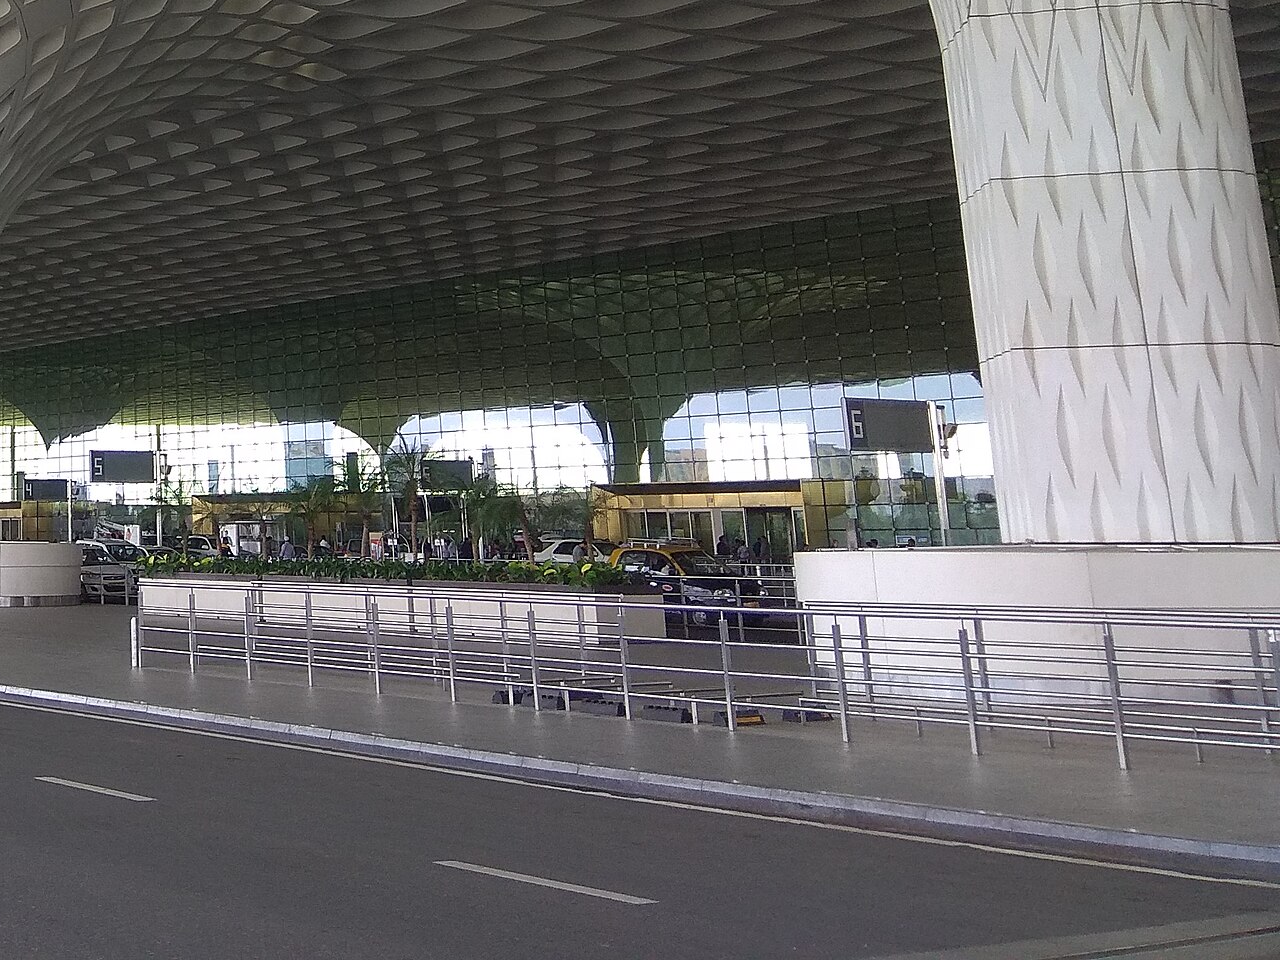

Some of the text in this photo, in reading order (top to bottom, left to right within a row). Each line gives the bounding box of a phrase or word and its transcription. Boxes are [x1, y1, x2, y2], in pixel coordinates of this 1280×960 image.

[850, 409, 864, 439] 6
[94, 457, 103, 476] 5
[25, 483, 33, 497] 4
